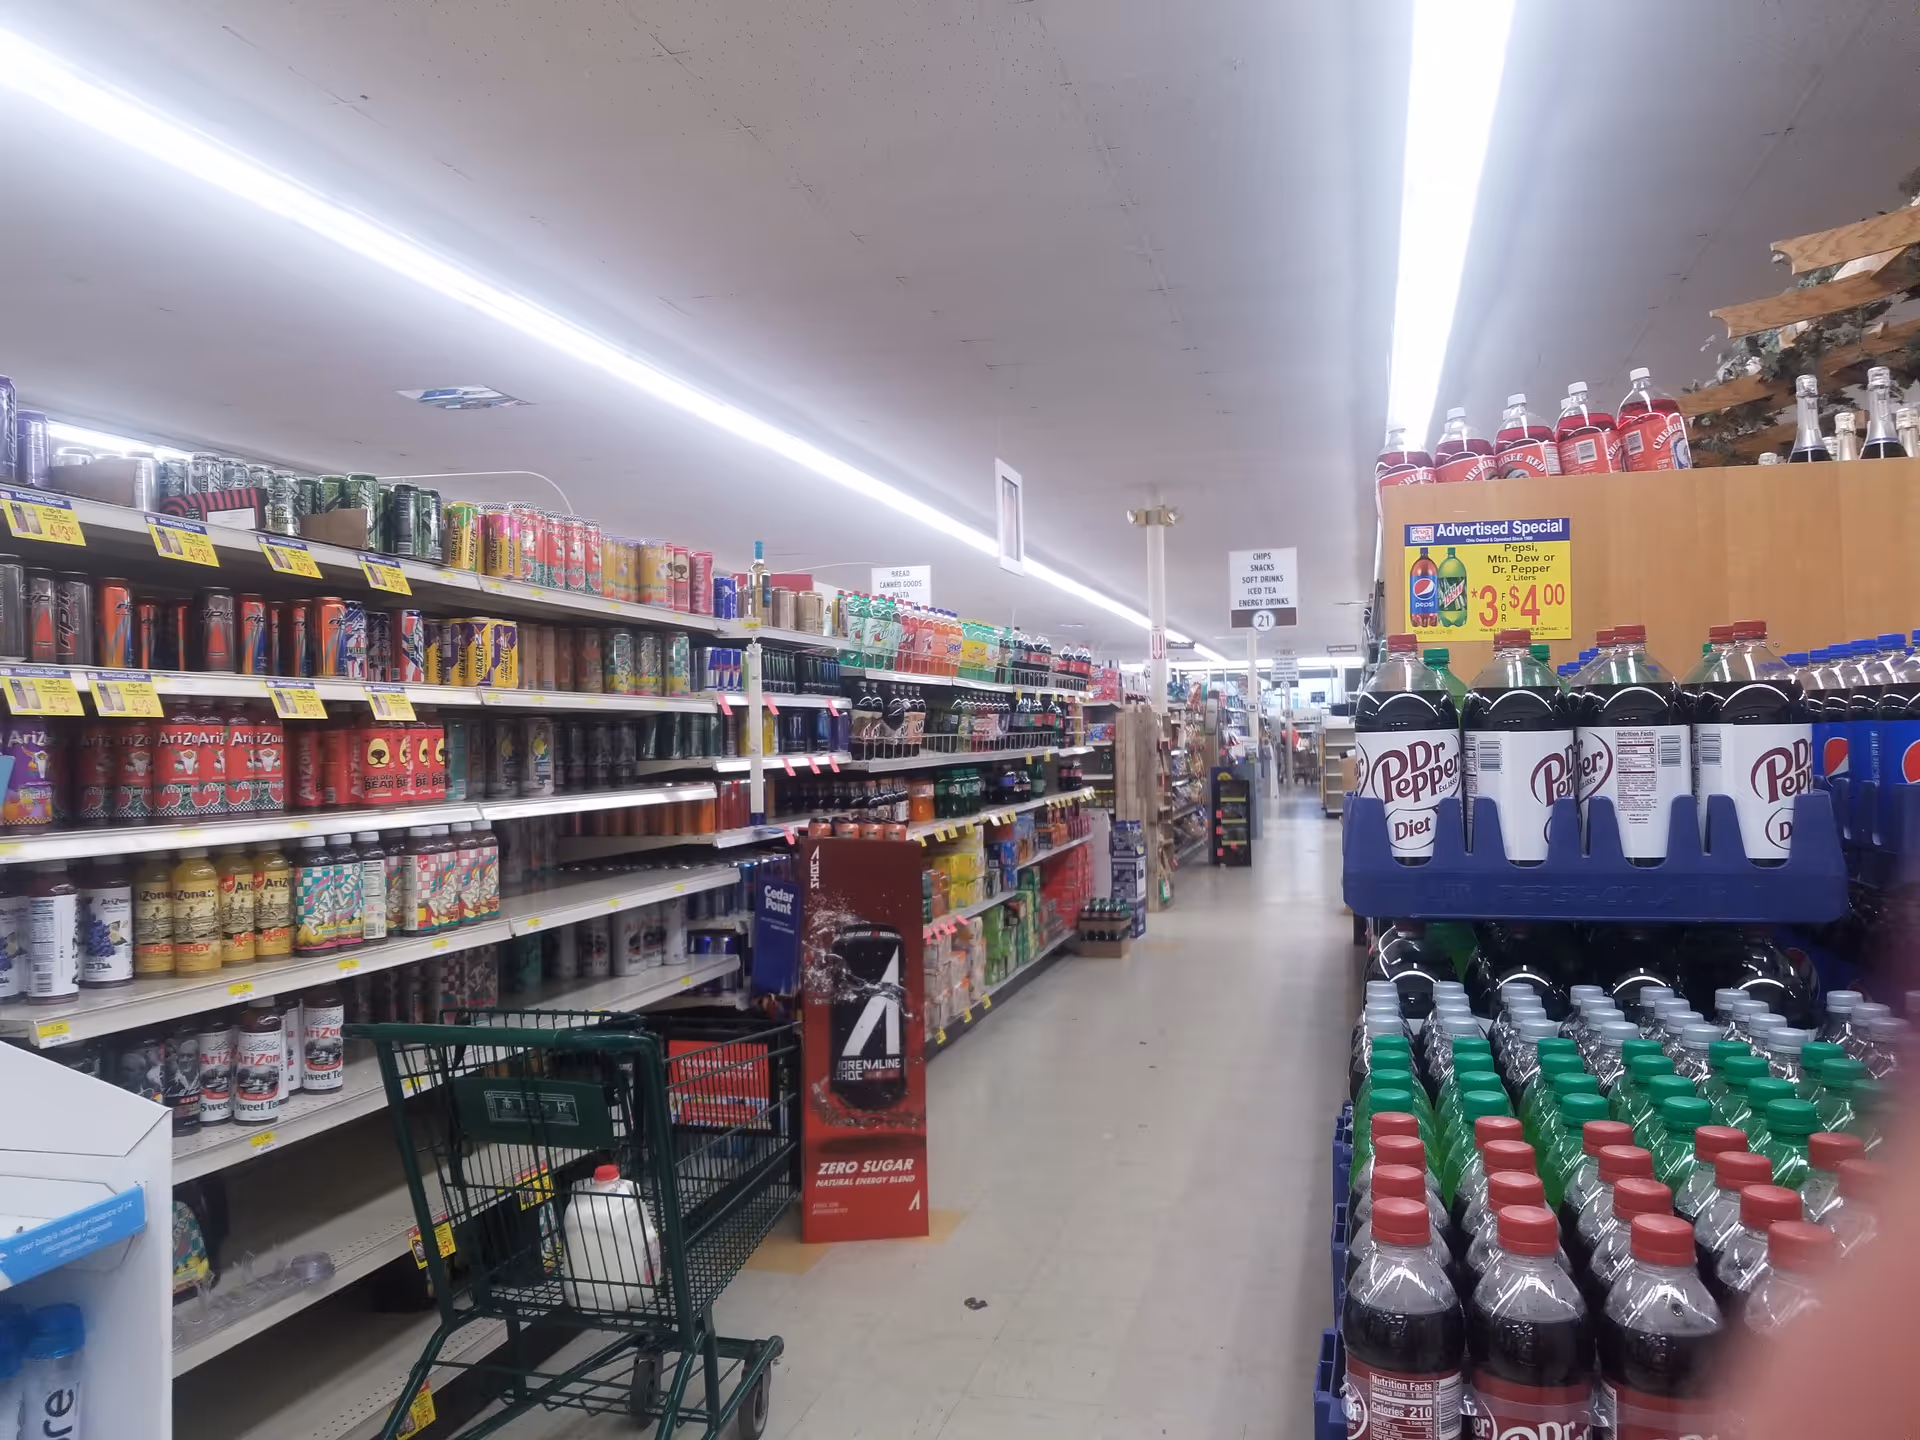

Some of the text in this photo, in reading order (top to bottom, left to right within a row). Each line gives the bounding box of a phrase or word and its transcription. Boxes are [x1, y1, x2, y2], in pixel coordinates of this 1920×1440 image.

[1525, 455, 1546, 472] RED
[1437, 519, 1563, 537] Advertised Special
[1504, 543, 1538, 553] Pepsi,
[1252, 552, 1272, 561] CHIPS
[1487, 553, 1556, 564] Mtn. Dew or
[1250, 563, 1275, 572] SNACKS
[1492, 564, 1551, 575] Dr. Pepper
[903, 580, 922, 588] GOODS
[1241, 574, 1284, 584] SOFT DRINKS
[1247, 586, 1277, 595] ICED TEA
[1238, 597, 1289, 607] ENERGY DRINKS
[1257, 614, 1270, 627] 21
[1406, 740, 1446, 774] Dr
[1381, 749, 1461, 804] Pepper
[364, 780, 394, 791] BEAR
[1393, 816, 1432, 842] Diet
[763, 884, 795, 904] Cedar
[765, 897, 792, 916] Point
[817, 1158, 914, 1176] ZERO SUGAR
[815, 1174, 916, 1188] NATURAL ENERGY BLEND
[1371, 1374, 1433, 1391] Nutrition Facts
[1371, 1383, 1393, 1397] Serving
[1393, 1390, 1406, 1398] size
[1371, 1401, 1405, 1418] Calories
[1409, 1406, 1433, 1418] 210
